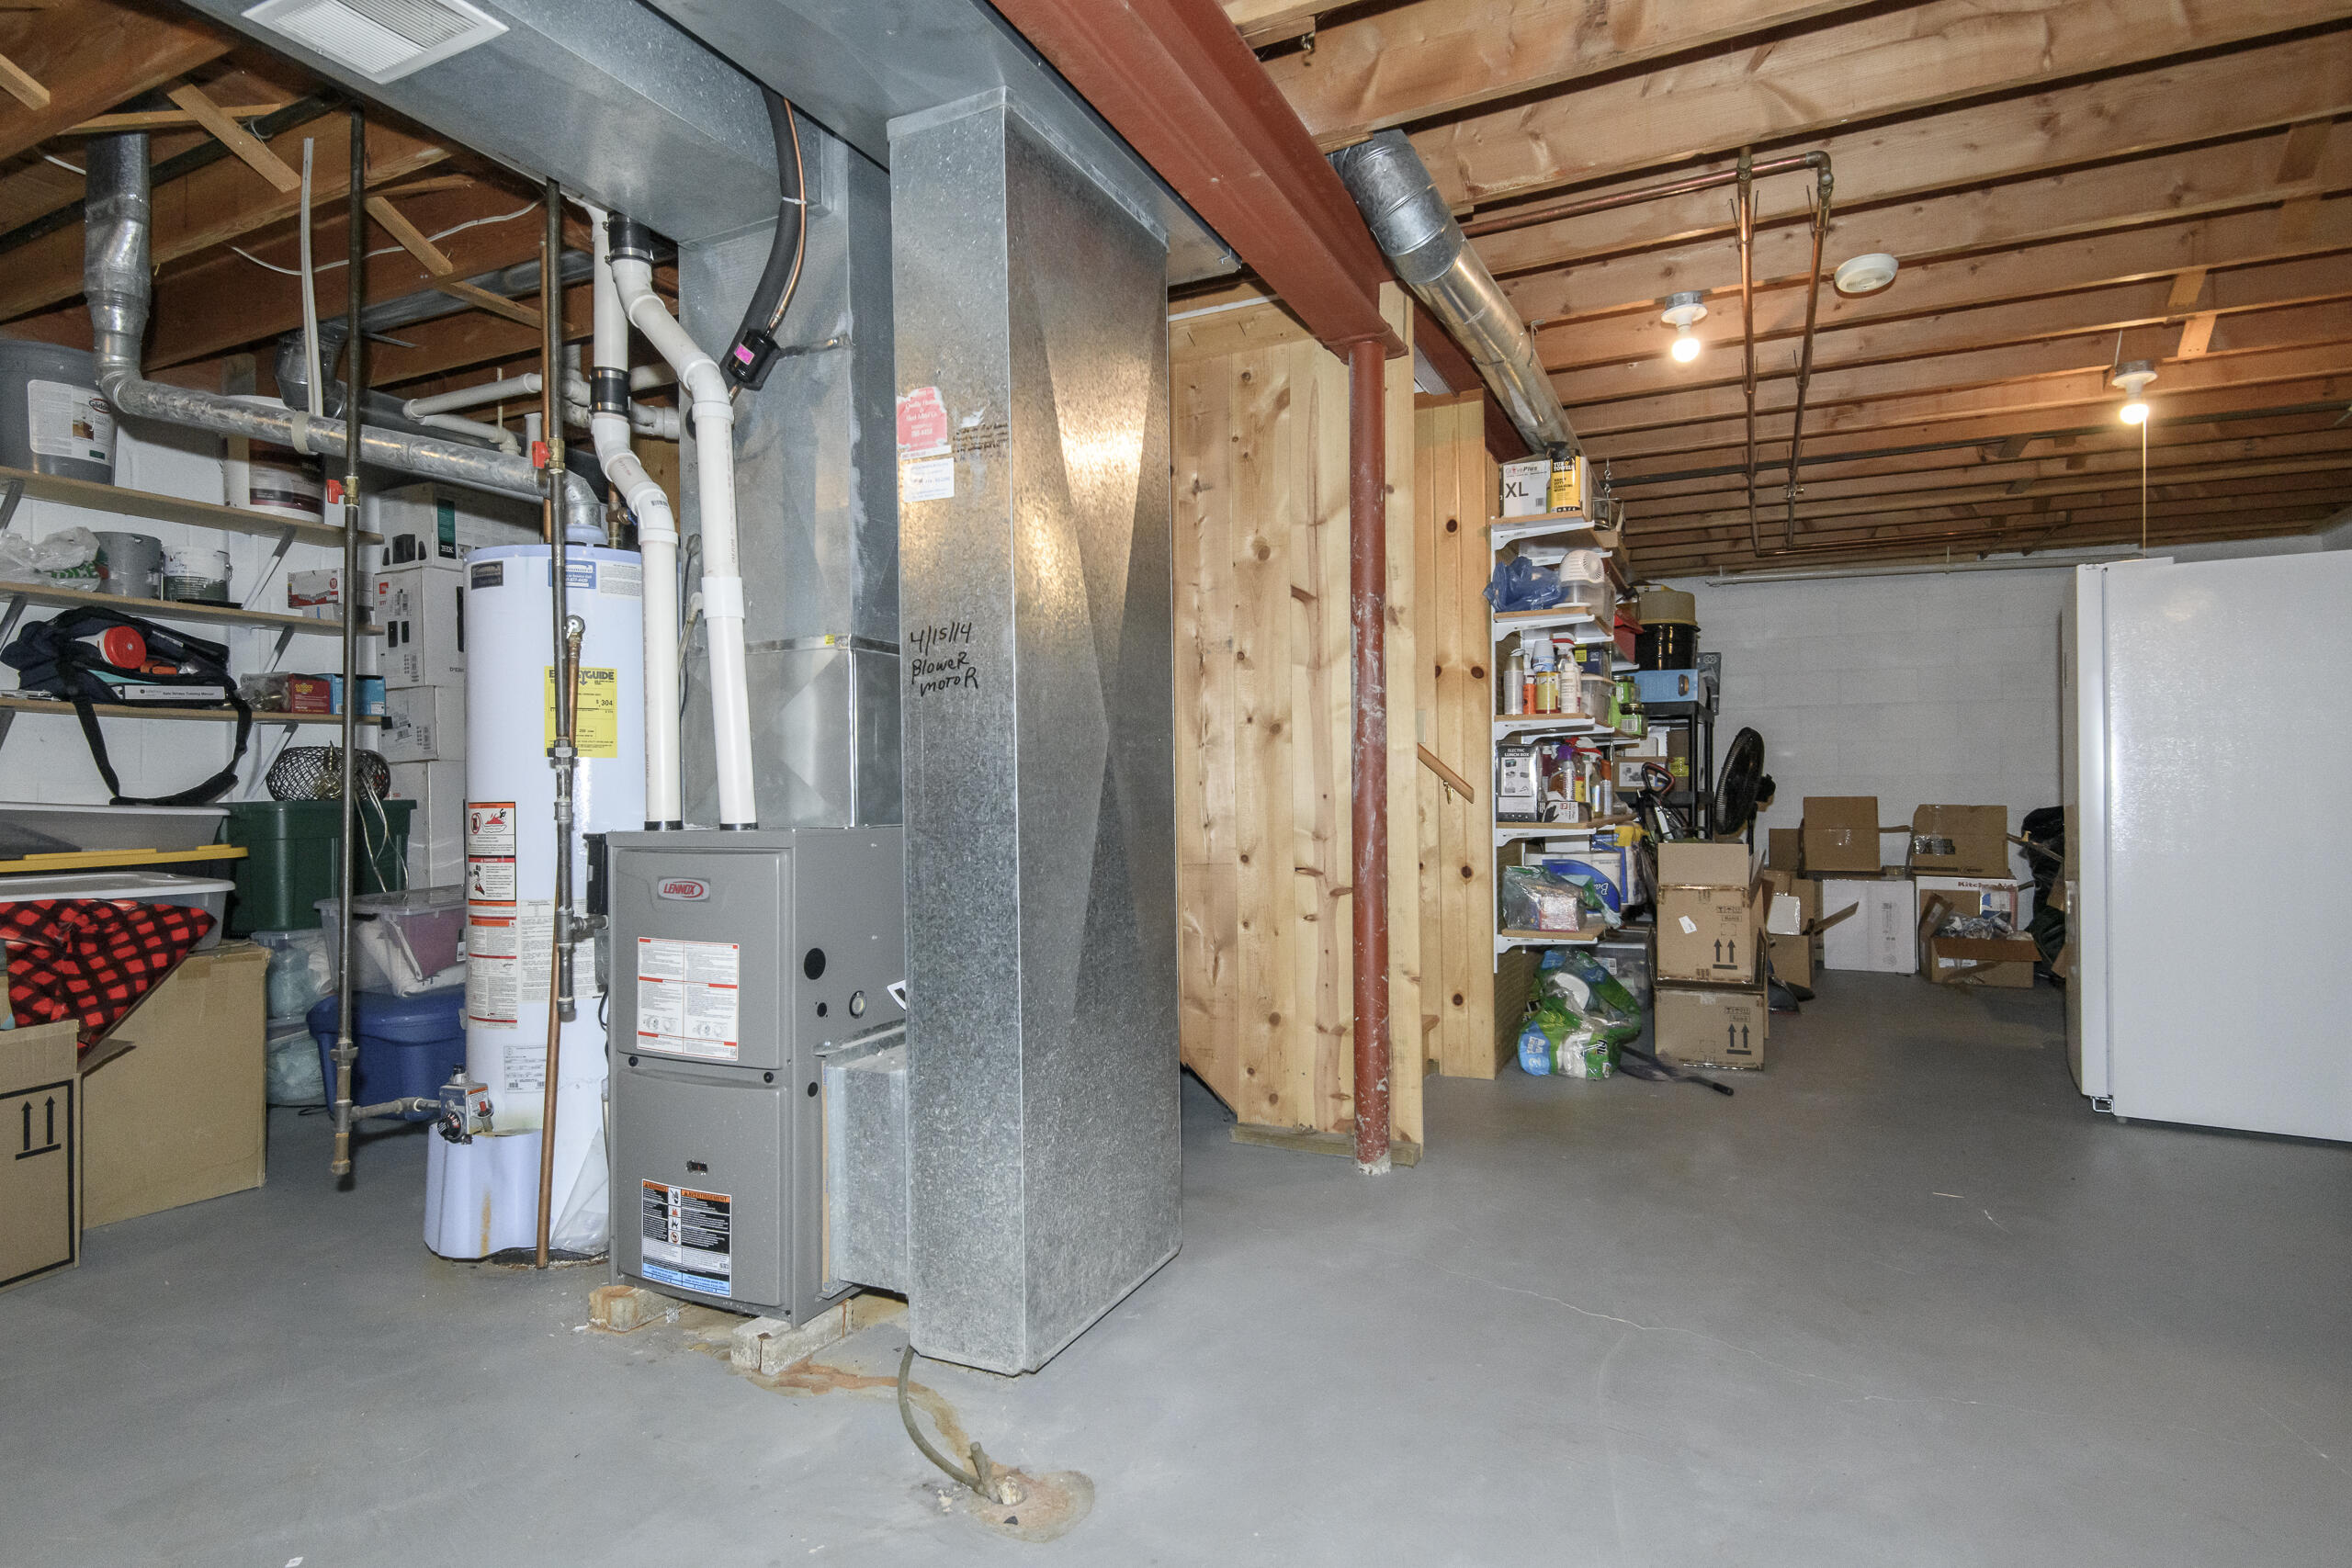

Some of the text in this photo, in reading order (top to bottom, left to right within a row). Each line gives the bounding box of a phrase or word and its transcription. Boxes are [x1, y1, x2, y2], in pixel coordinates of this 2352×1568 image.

[1505, 481, 1529, 499] XL
[910, 622, 972, 657] 4/15/14
[548, 669, 615, 681] EYGUIDE
[662, 882, 696, 896] LENNOX
